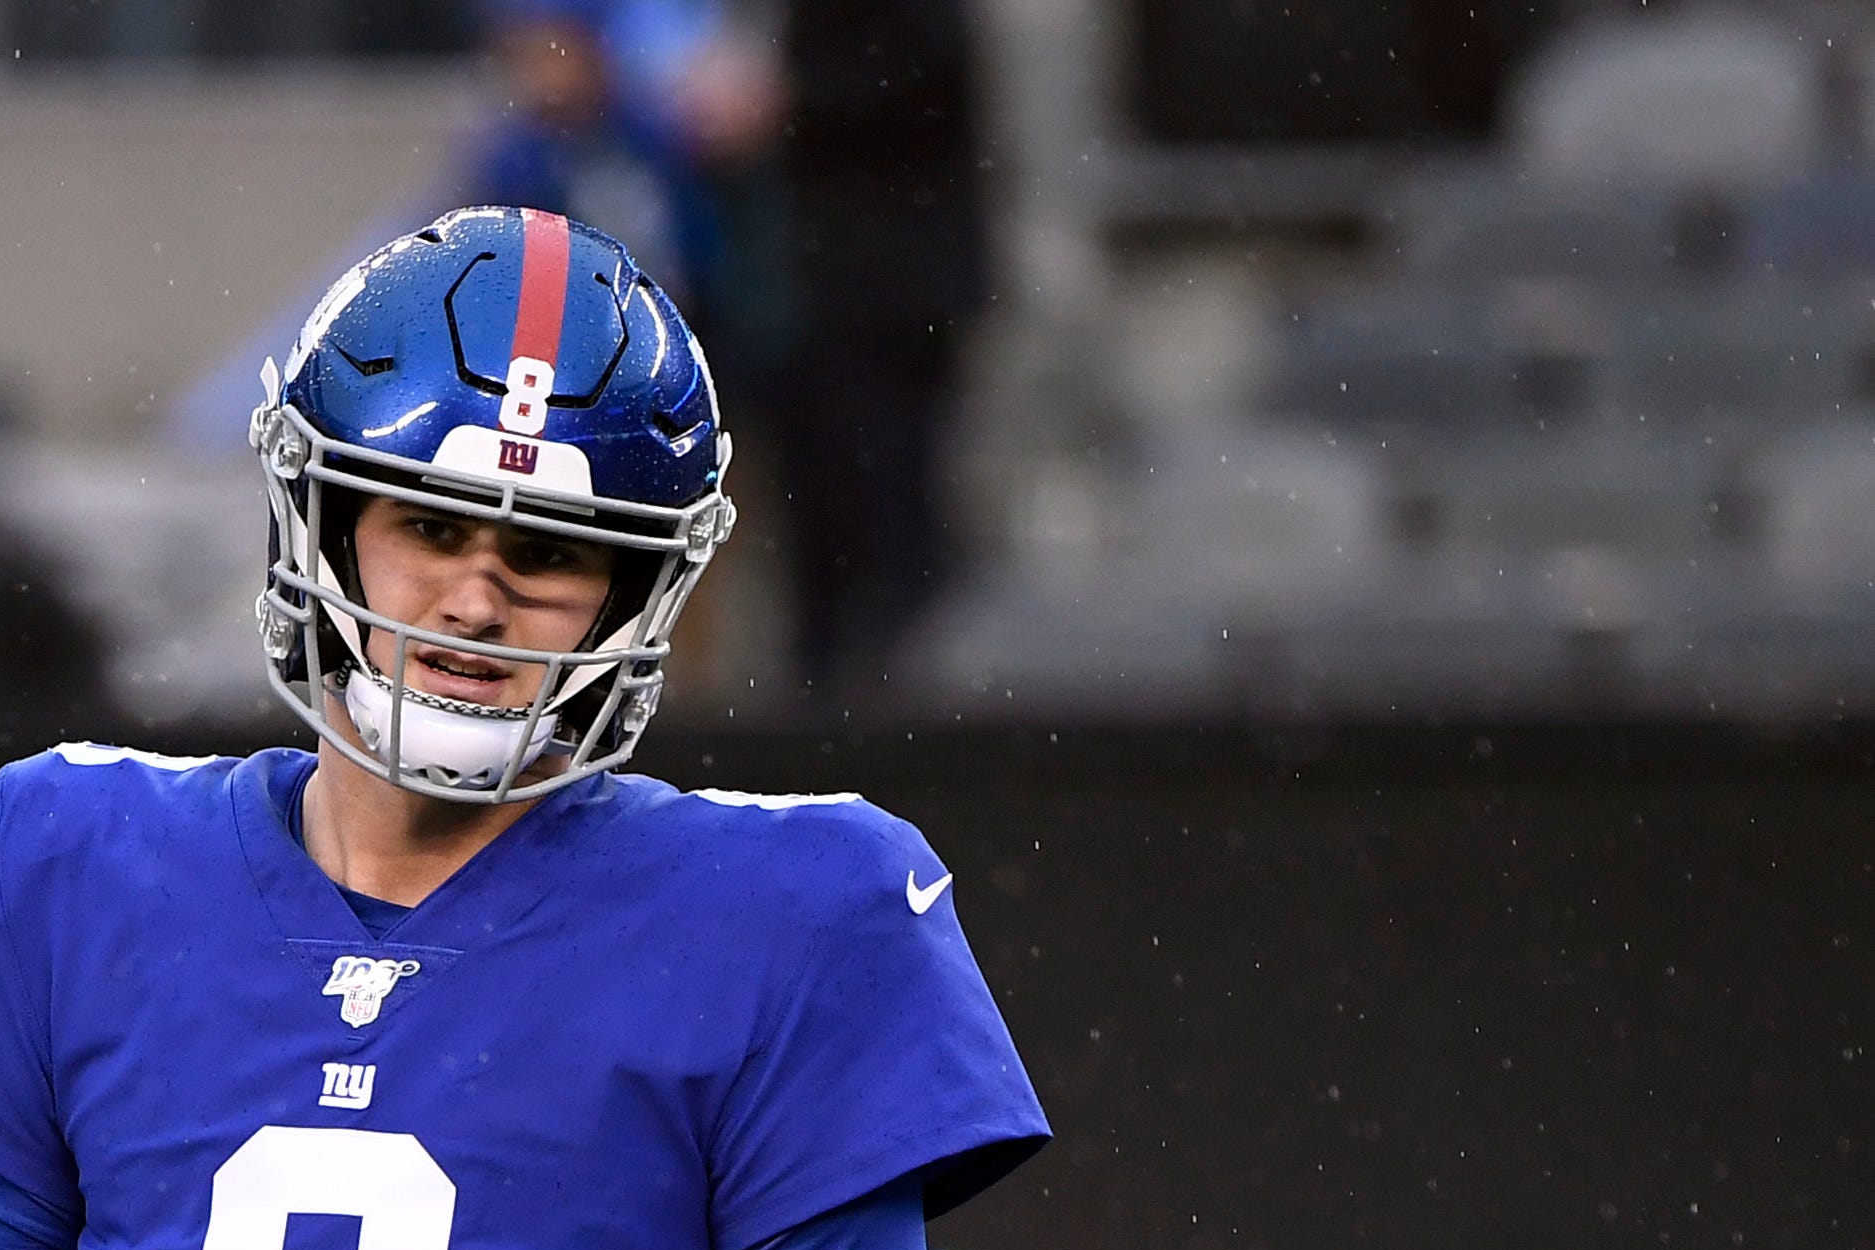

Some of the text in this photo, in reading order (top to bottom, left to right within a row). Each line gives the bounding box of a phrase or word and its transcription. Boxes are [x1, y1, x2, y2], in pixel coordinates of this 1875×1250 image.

[498, 355, 555, 436] 8
[498, 439, 539, 476] ny
[347, 1001, 371, 1018] NFL
[318, 1063, 377, 1110] ny
